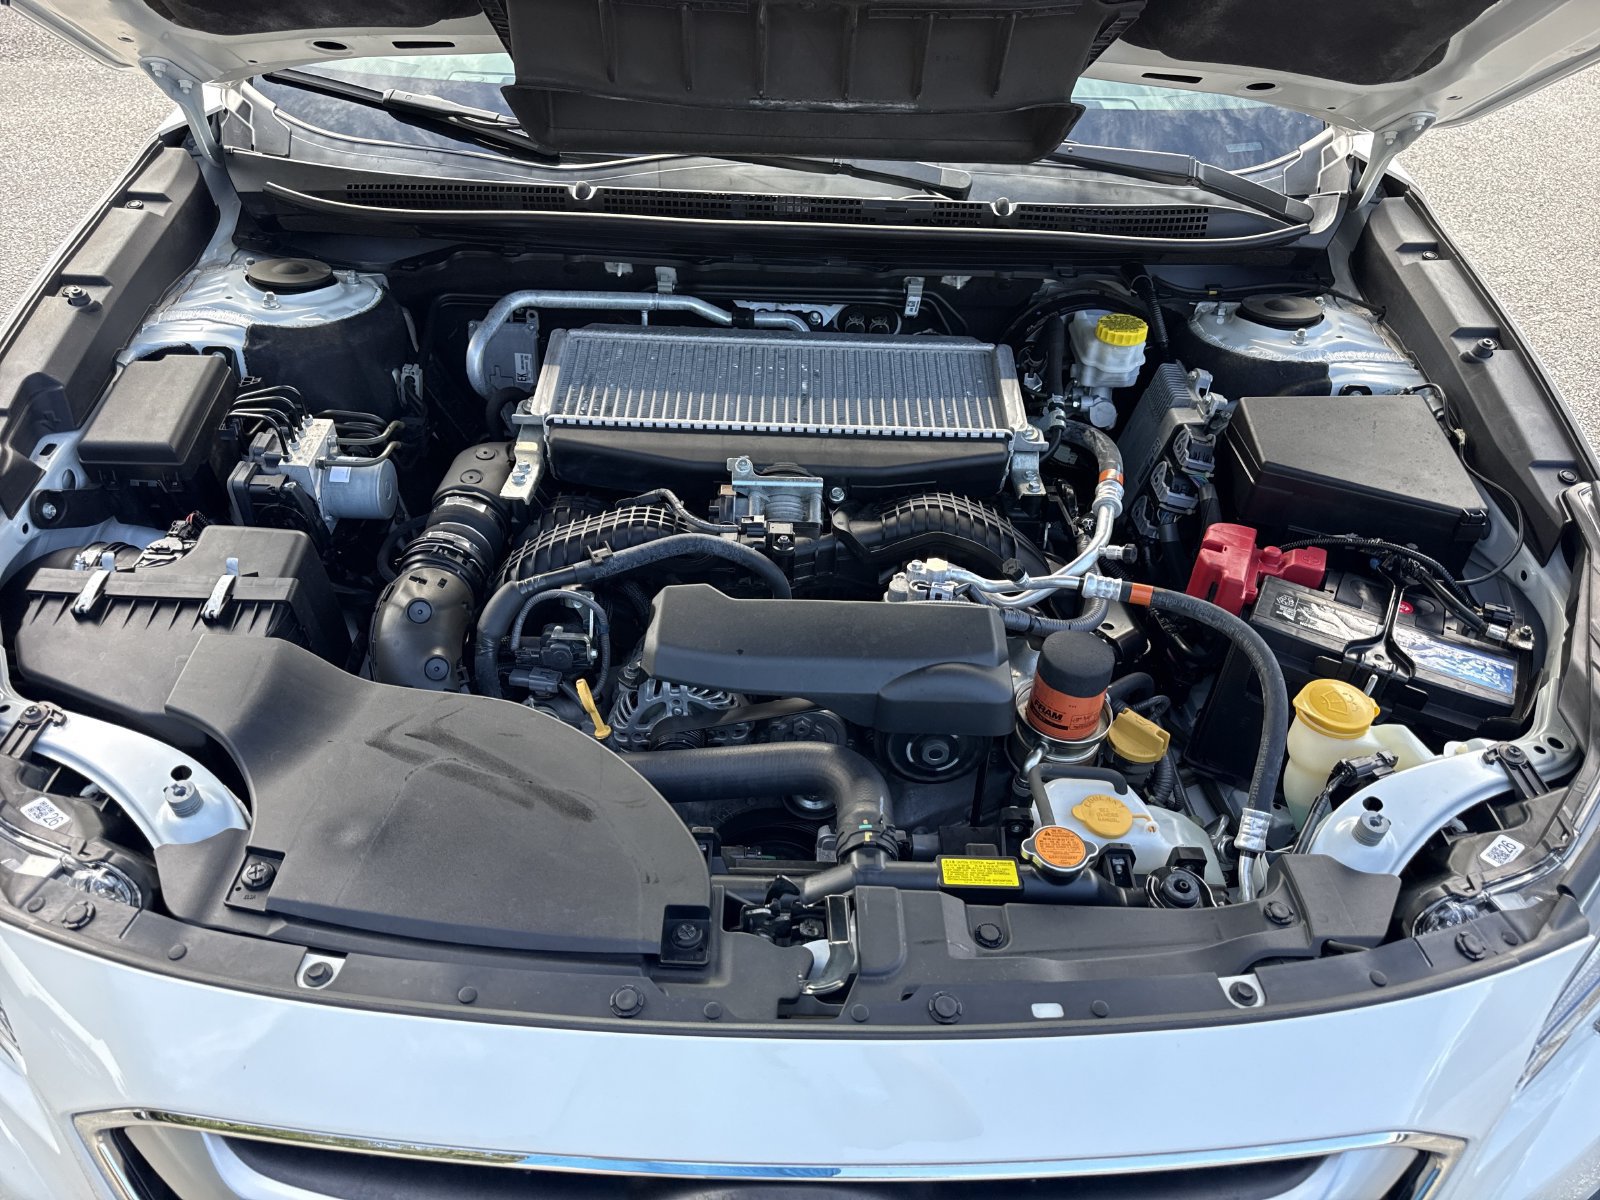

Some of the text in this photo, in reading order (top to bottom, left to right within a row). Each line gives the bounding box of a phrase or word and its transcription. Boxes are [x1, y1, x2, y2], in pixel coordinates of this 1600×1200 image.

[1033, 699, 1063, 721] FRAM
[1084, 795, 1126, 808] COOLANT
[43, 813, 63, 826] 26
[1499, 840, 1516, 853] 26
